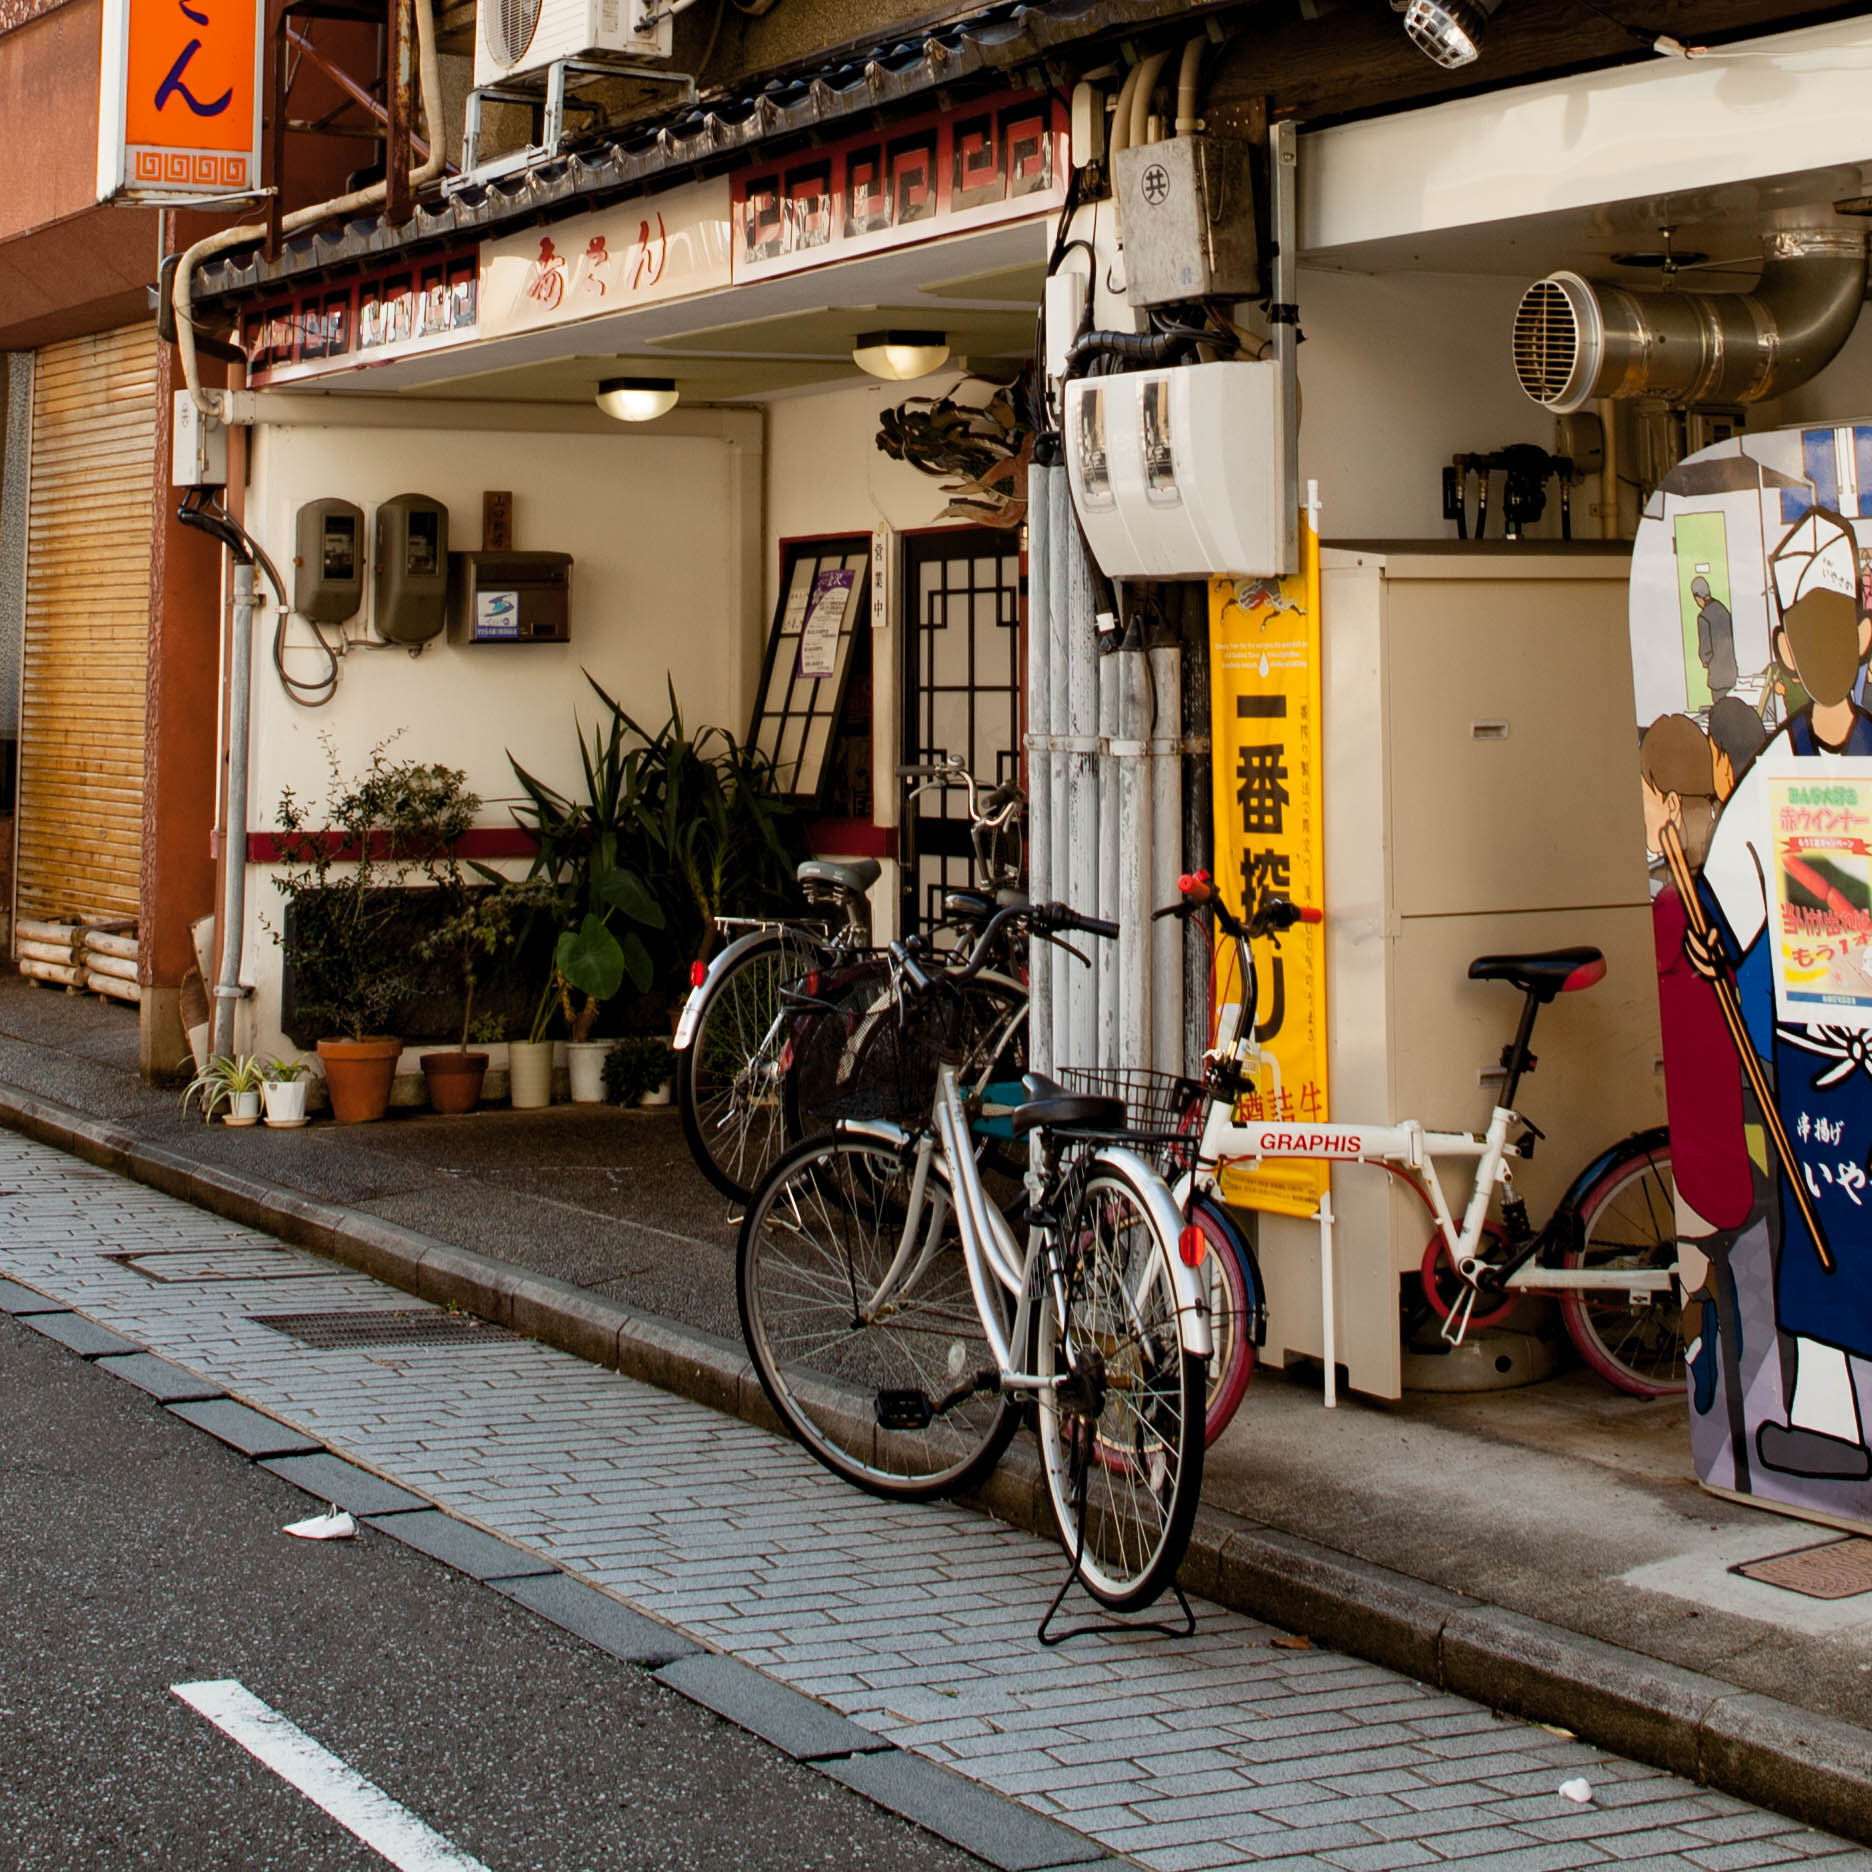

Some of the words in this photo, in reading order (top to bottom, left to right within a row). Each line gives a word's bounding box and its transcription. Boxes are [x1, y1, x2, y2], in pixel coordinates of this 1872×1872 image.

[1779, 806, 1870, 833] 赤ウインナー
[1797, 1111, 1845, 1146] 串揚げ
[1260, 1133, 1361, 1153] GRAPHIS
